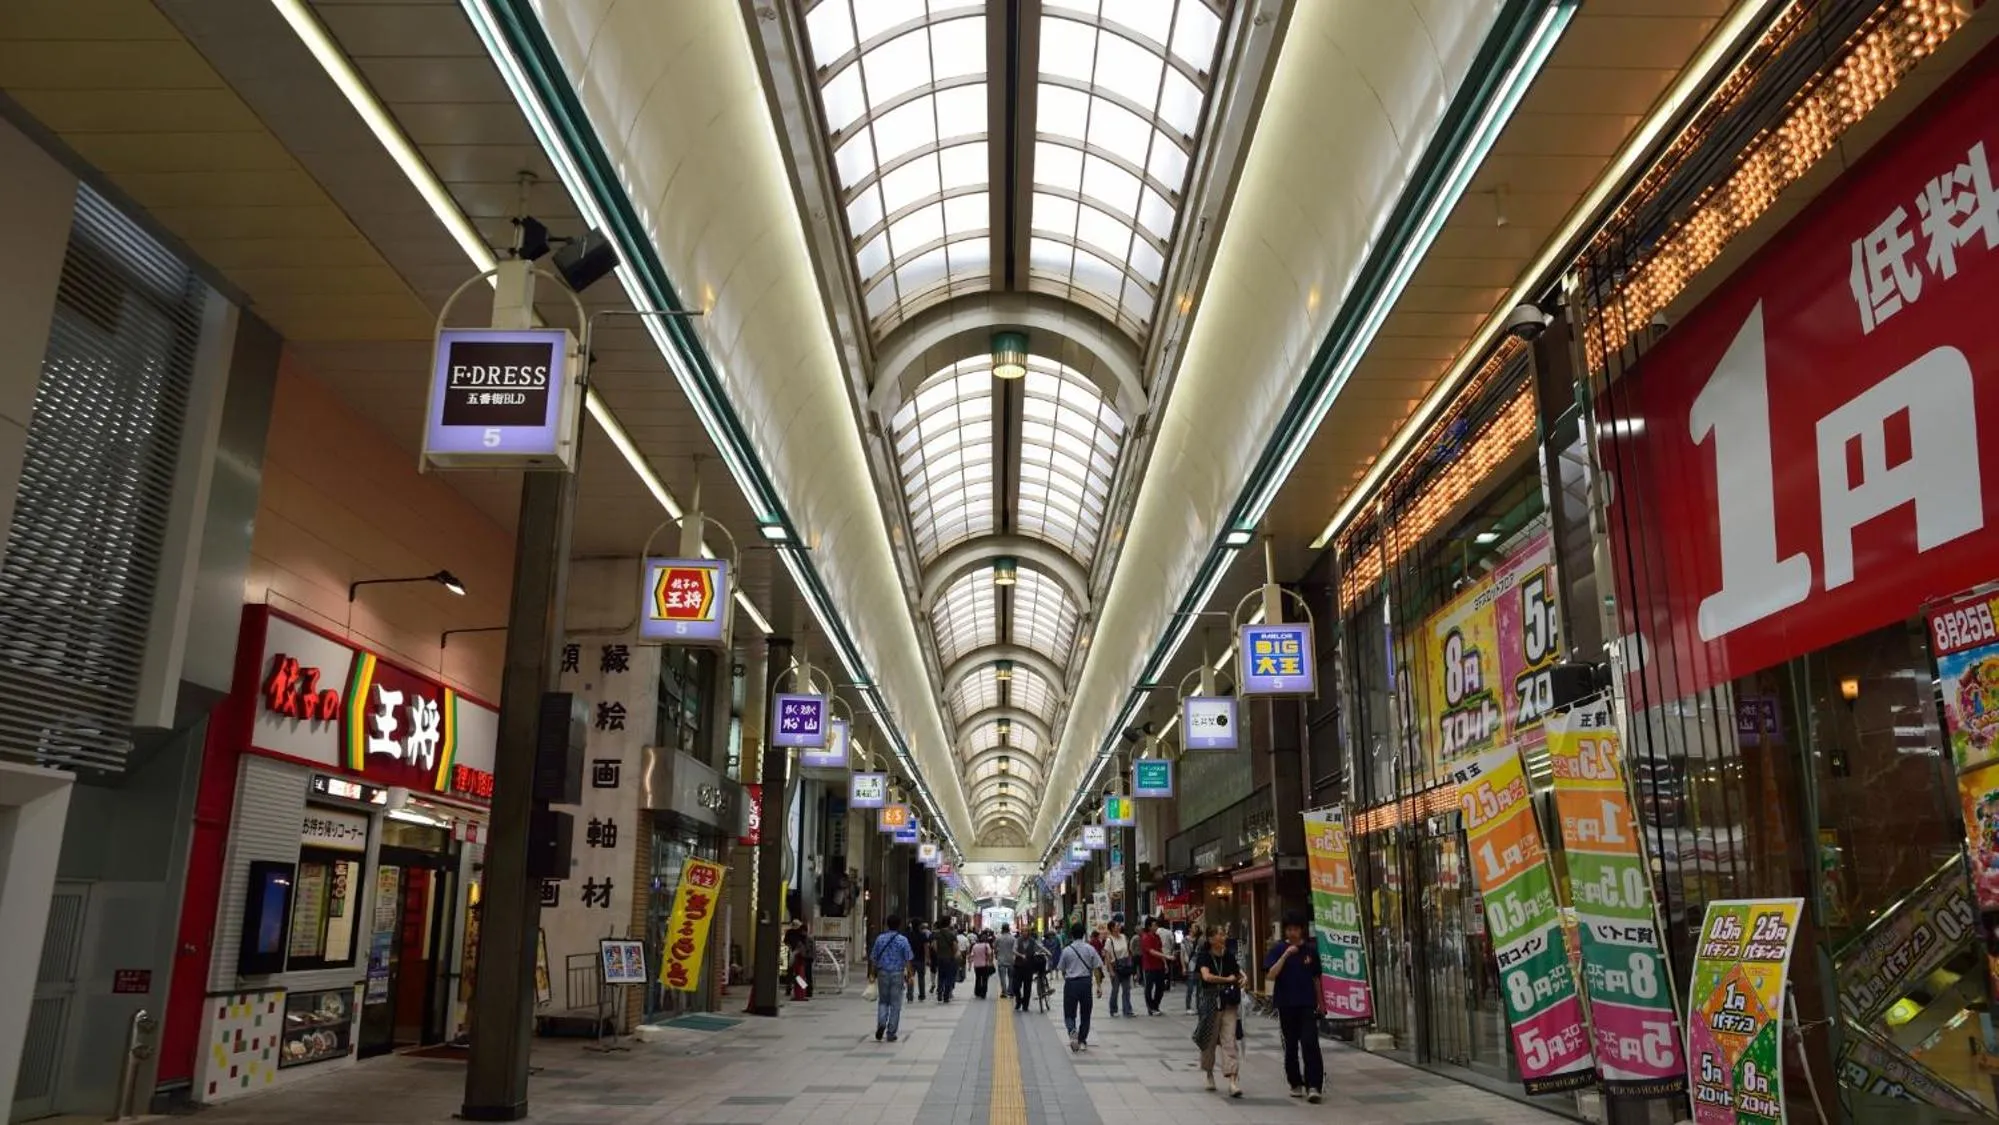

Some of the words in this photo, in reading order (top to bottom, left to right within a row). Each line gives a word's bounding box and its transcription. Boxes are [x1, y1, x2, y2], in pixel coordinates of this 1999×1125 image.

[483, 429, 502, 448] 5
[671, 578, 700, 589] 餃子の
[665, 591, 702, 609] 王将
[1933, 602, 1996, 650] 8月25日
[1255, 640, 1299, 654] BIG
[1256, 657, 1301, 675] 大王
[368, 683, 440, 771] 王将
